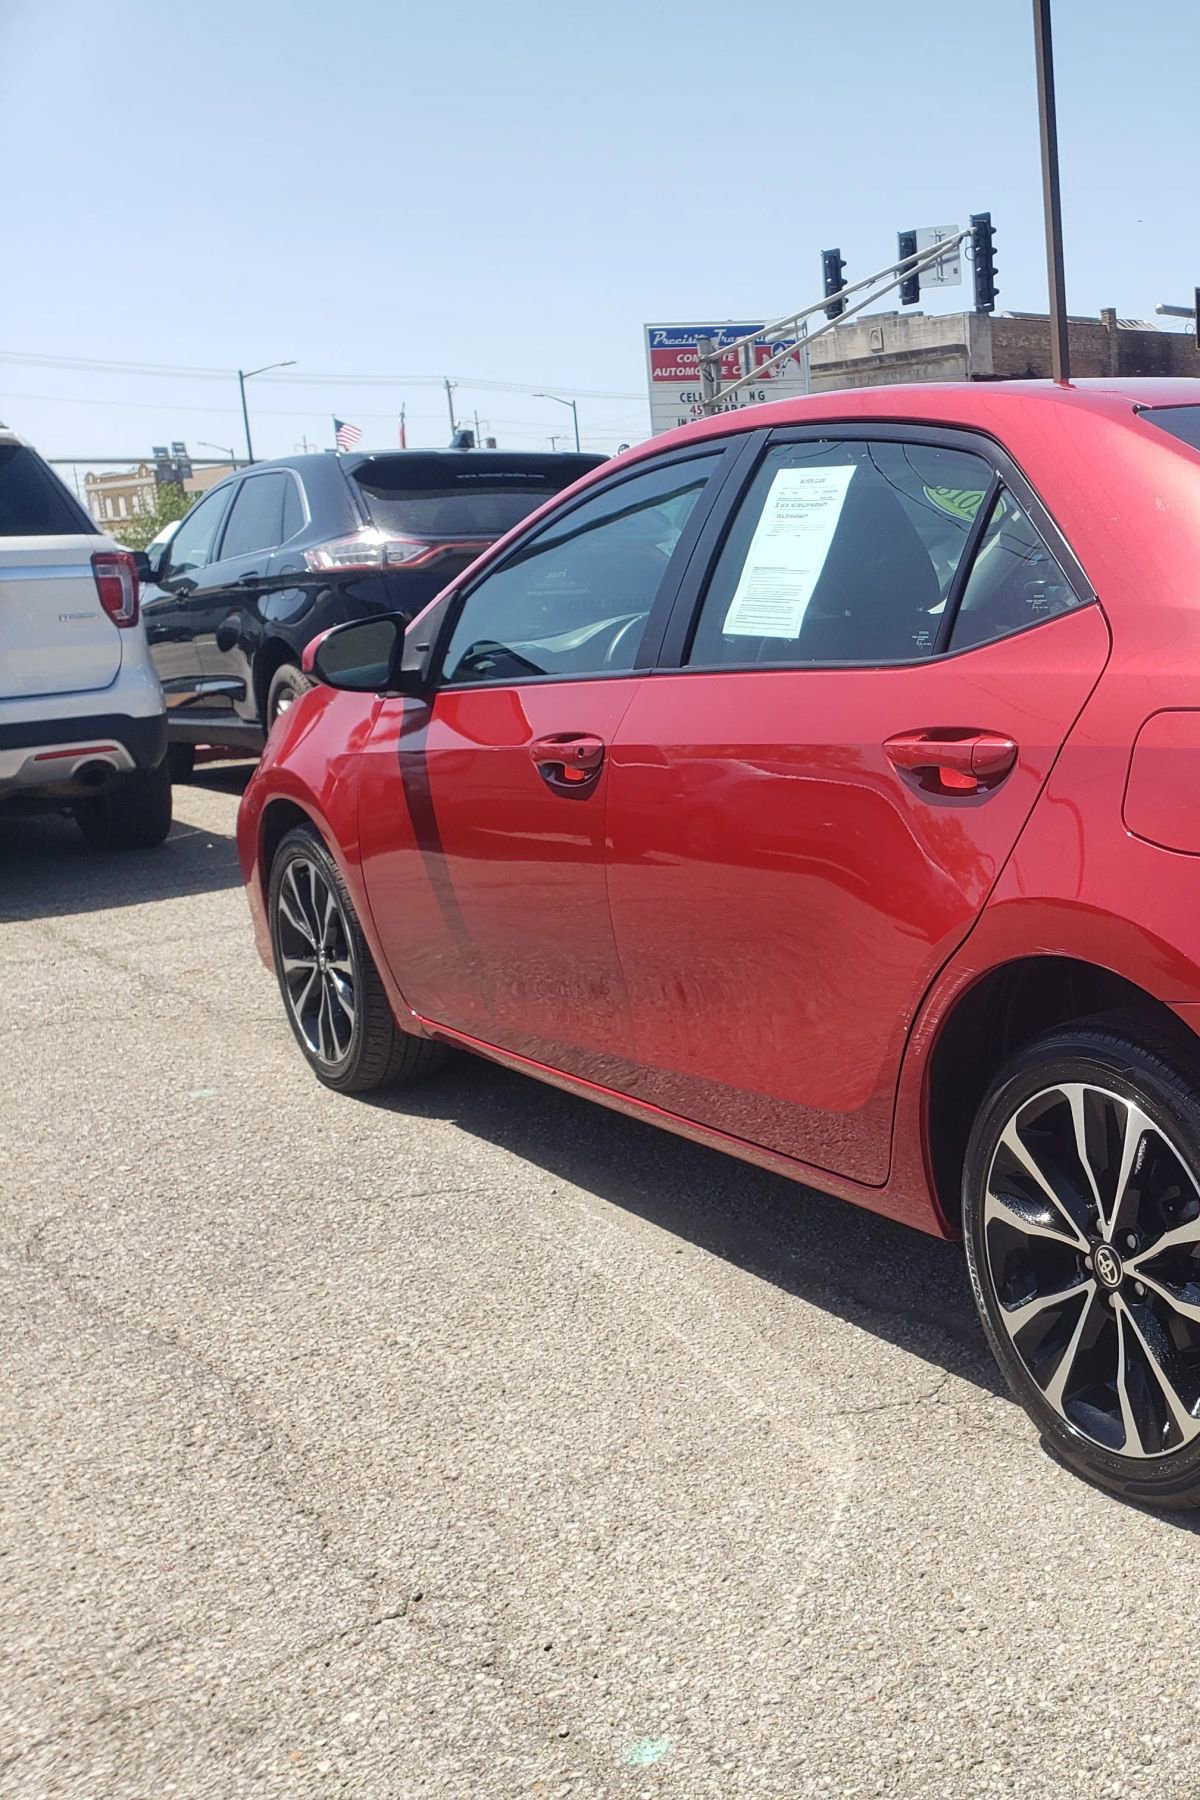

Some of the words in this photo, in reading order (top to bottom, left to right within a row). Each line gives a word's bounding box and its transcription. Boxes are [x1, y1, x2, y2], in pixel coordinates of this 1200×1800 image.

[653, 331, 701, 345] Precisi
[677, 352, 735, 364] COMTE
[653, 365, 731, 377] AUTOMOE
[690, 404, 703, 415] 45
